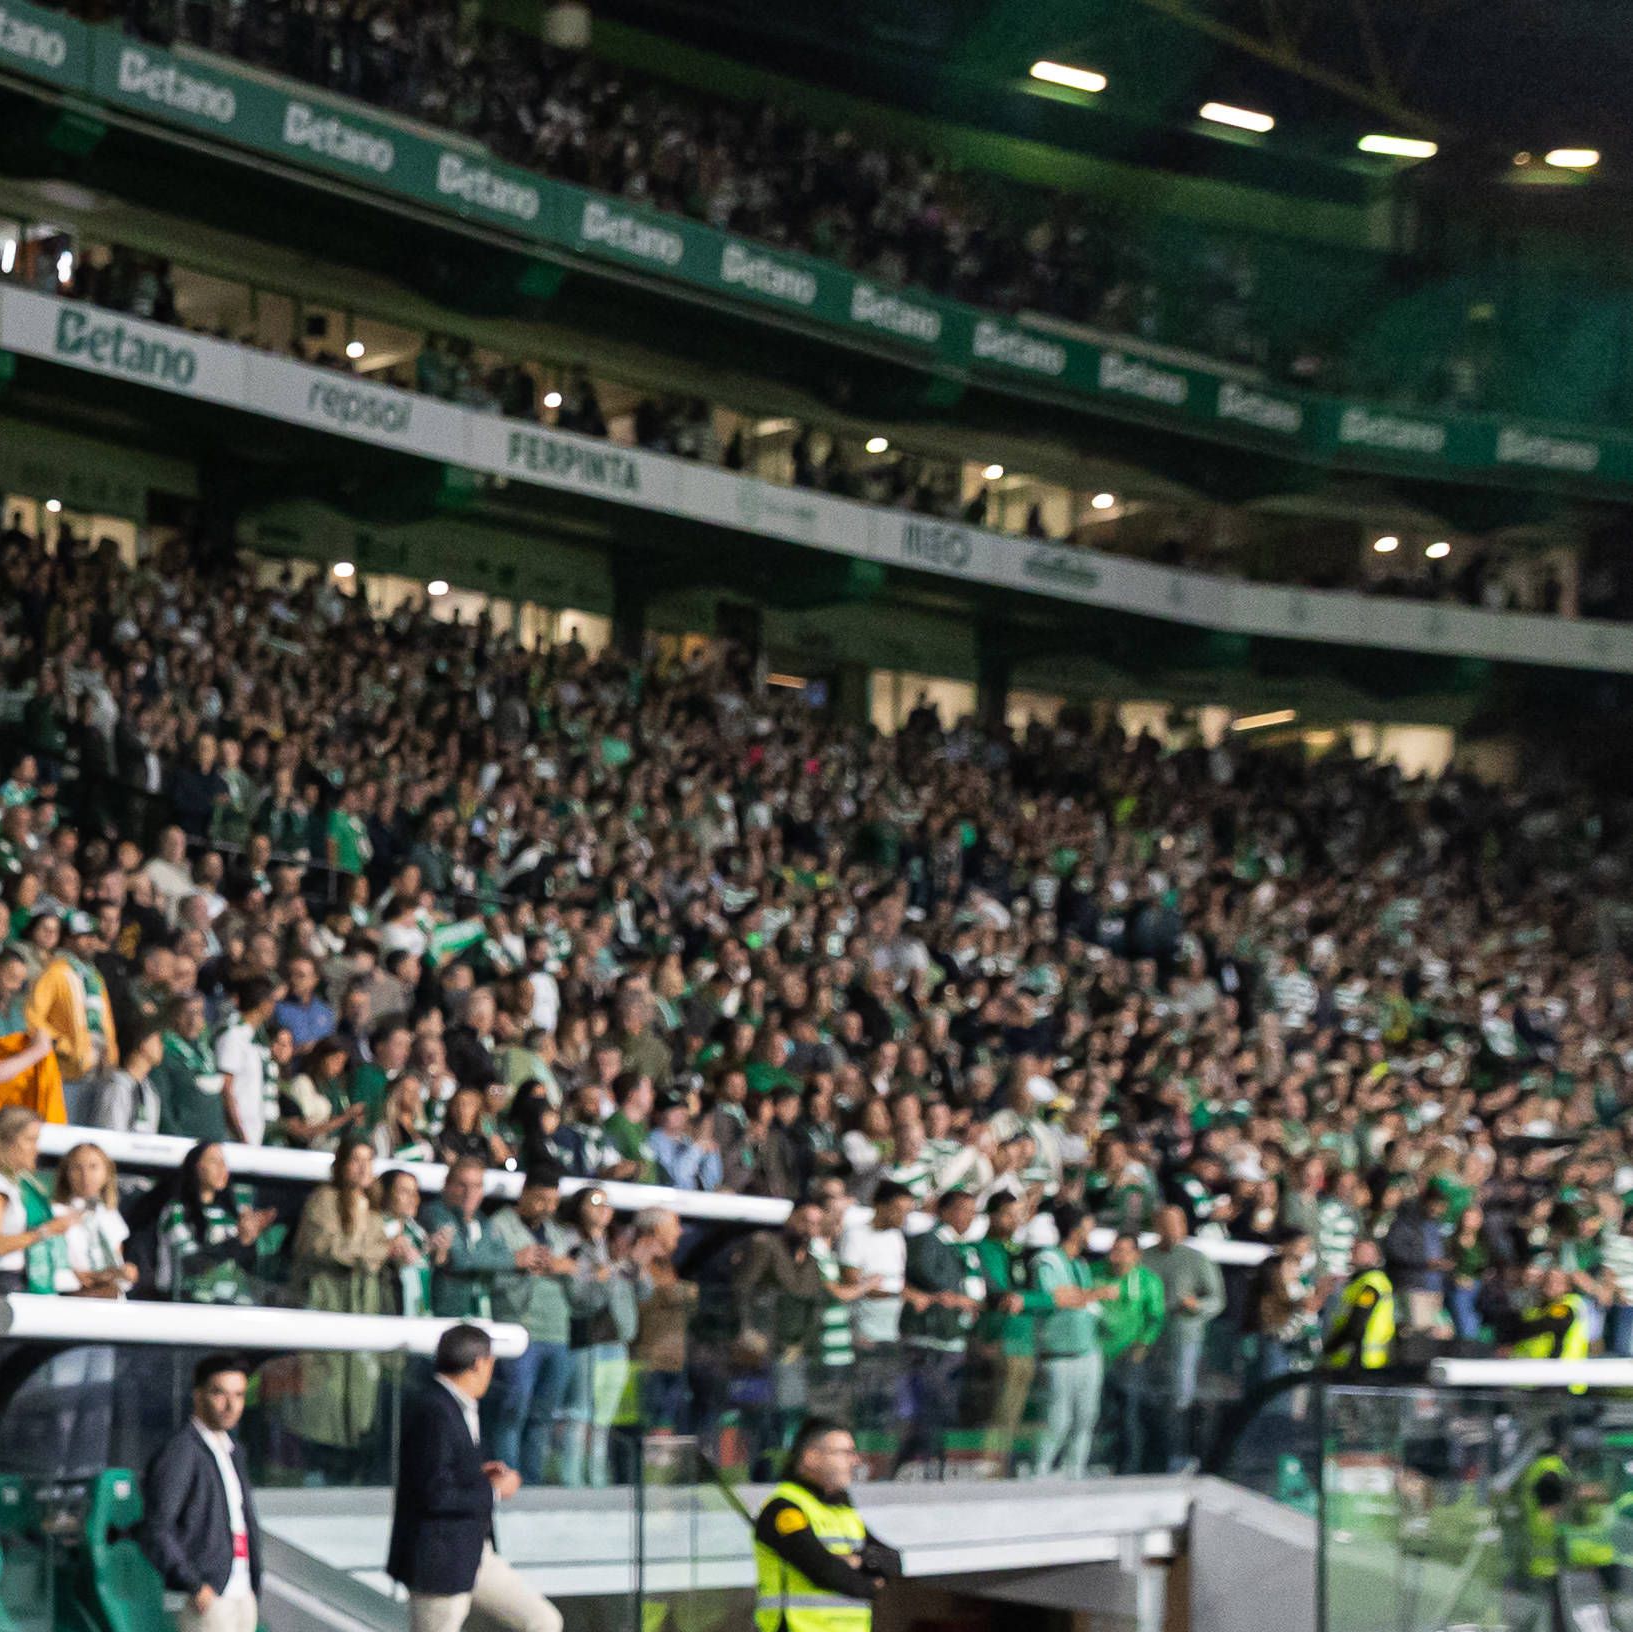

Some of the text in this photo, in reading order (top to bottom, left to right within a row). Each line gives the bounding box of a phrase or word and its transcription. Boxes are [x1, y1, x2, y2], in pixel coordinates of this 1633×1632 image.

[119, 48, 236, 123] Betano
[283, 103, 395, 172] Betano
[437, 153, 539, 221] Betano
[581, 201, 684, 266] Betano
[54, 306, 198, 386] Betano
[308, 380, 414, 434] repsol
[509, 430, 639, 491] FERPINTA
